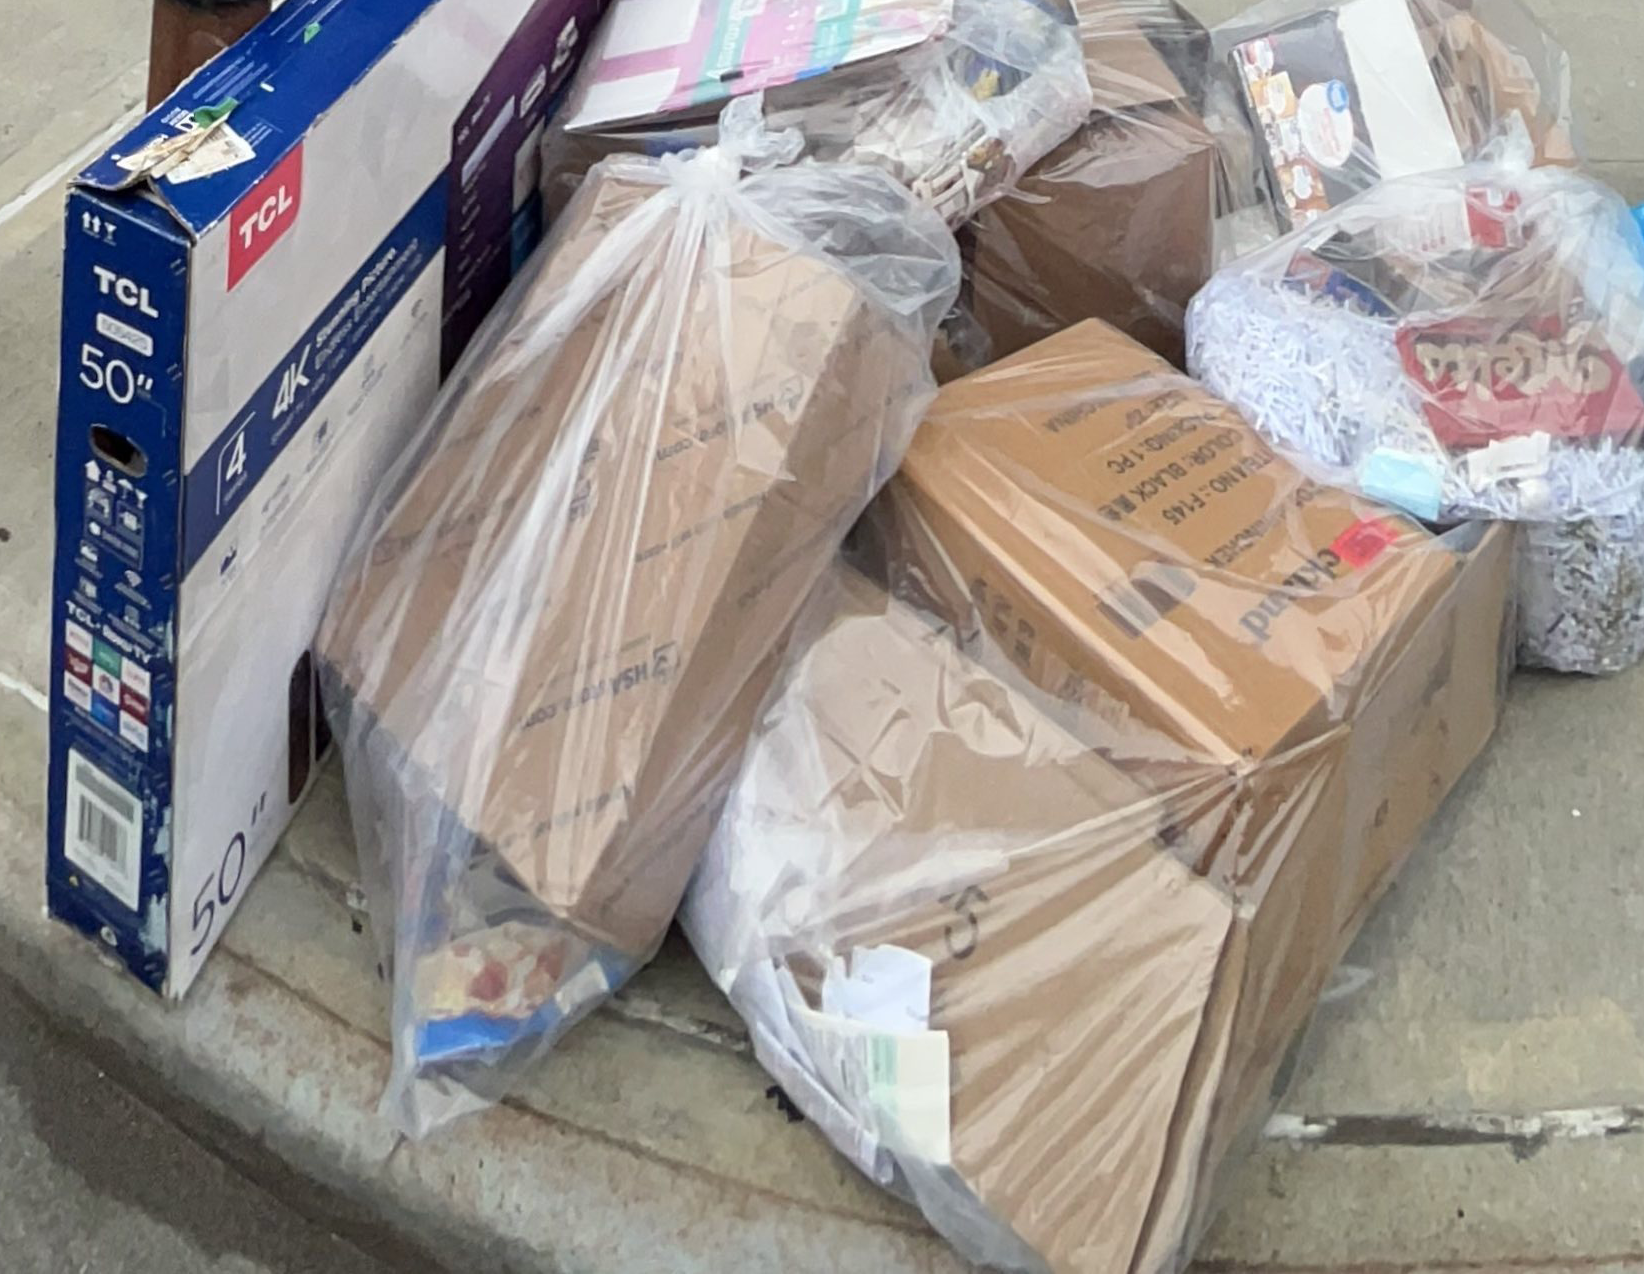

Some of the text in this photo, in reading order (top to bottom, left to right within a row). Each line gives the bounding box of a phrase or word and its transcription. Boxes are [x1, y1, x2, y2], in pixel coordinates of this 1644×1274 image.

[239, 185, 293, 249] TCL
[93, 265, 159, 319] TCL
[272, 343, 313, 421] 4K
[226, 430, 247, 482] 4
[1107, 453, 1136, 475] PC
[1129, 462, 1188, 502] BLACK
[1162, 492, 1206, 526] F145
